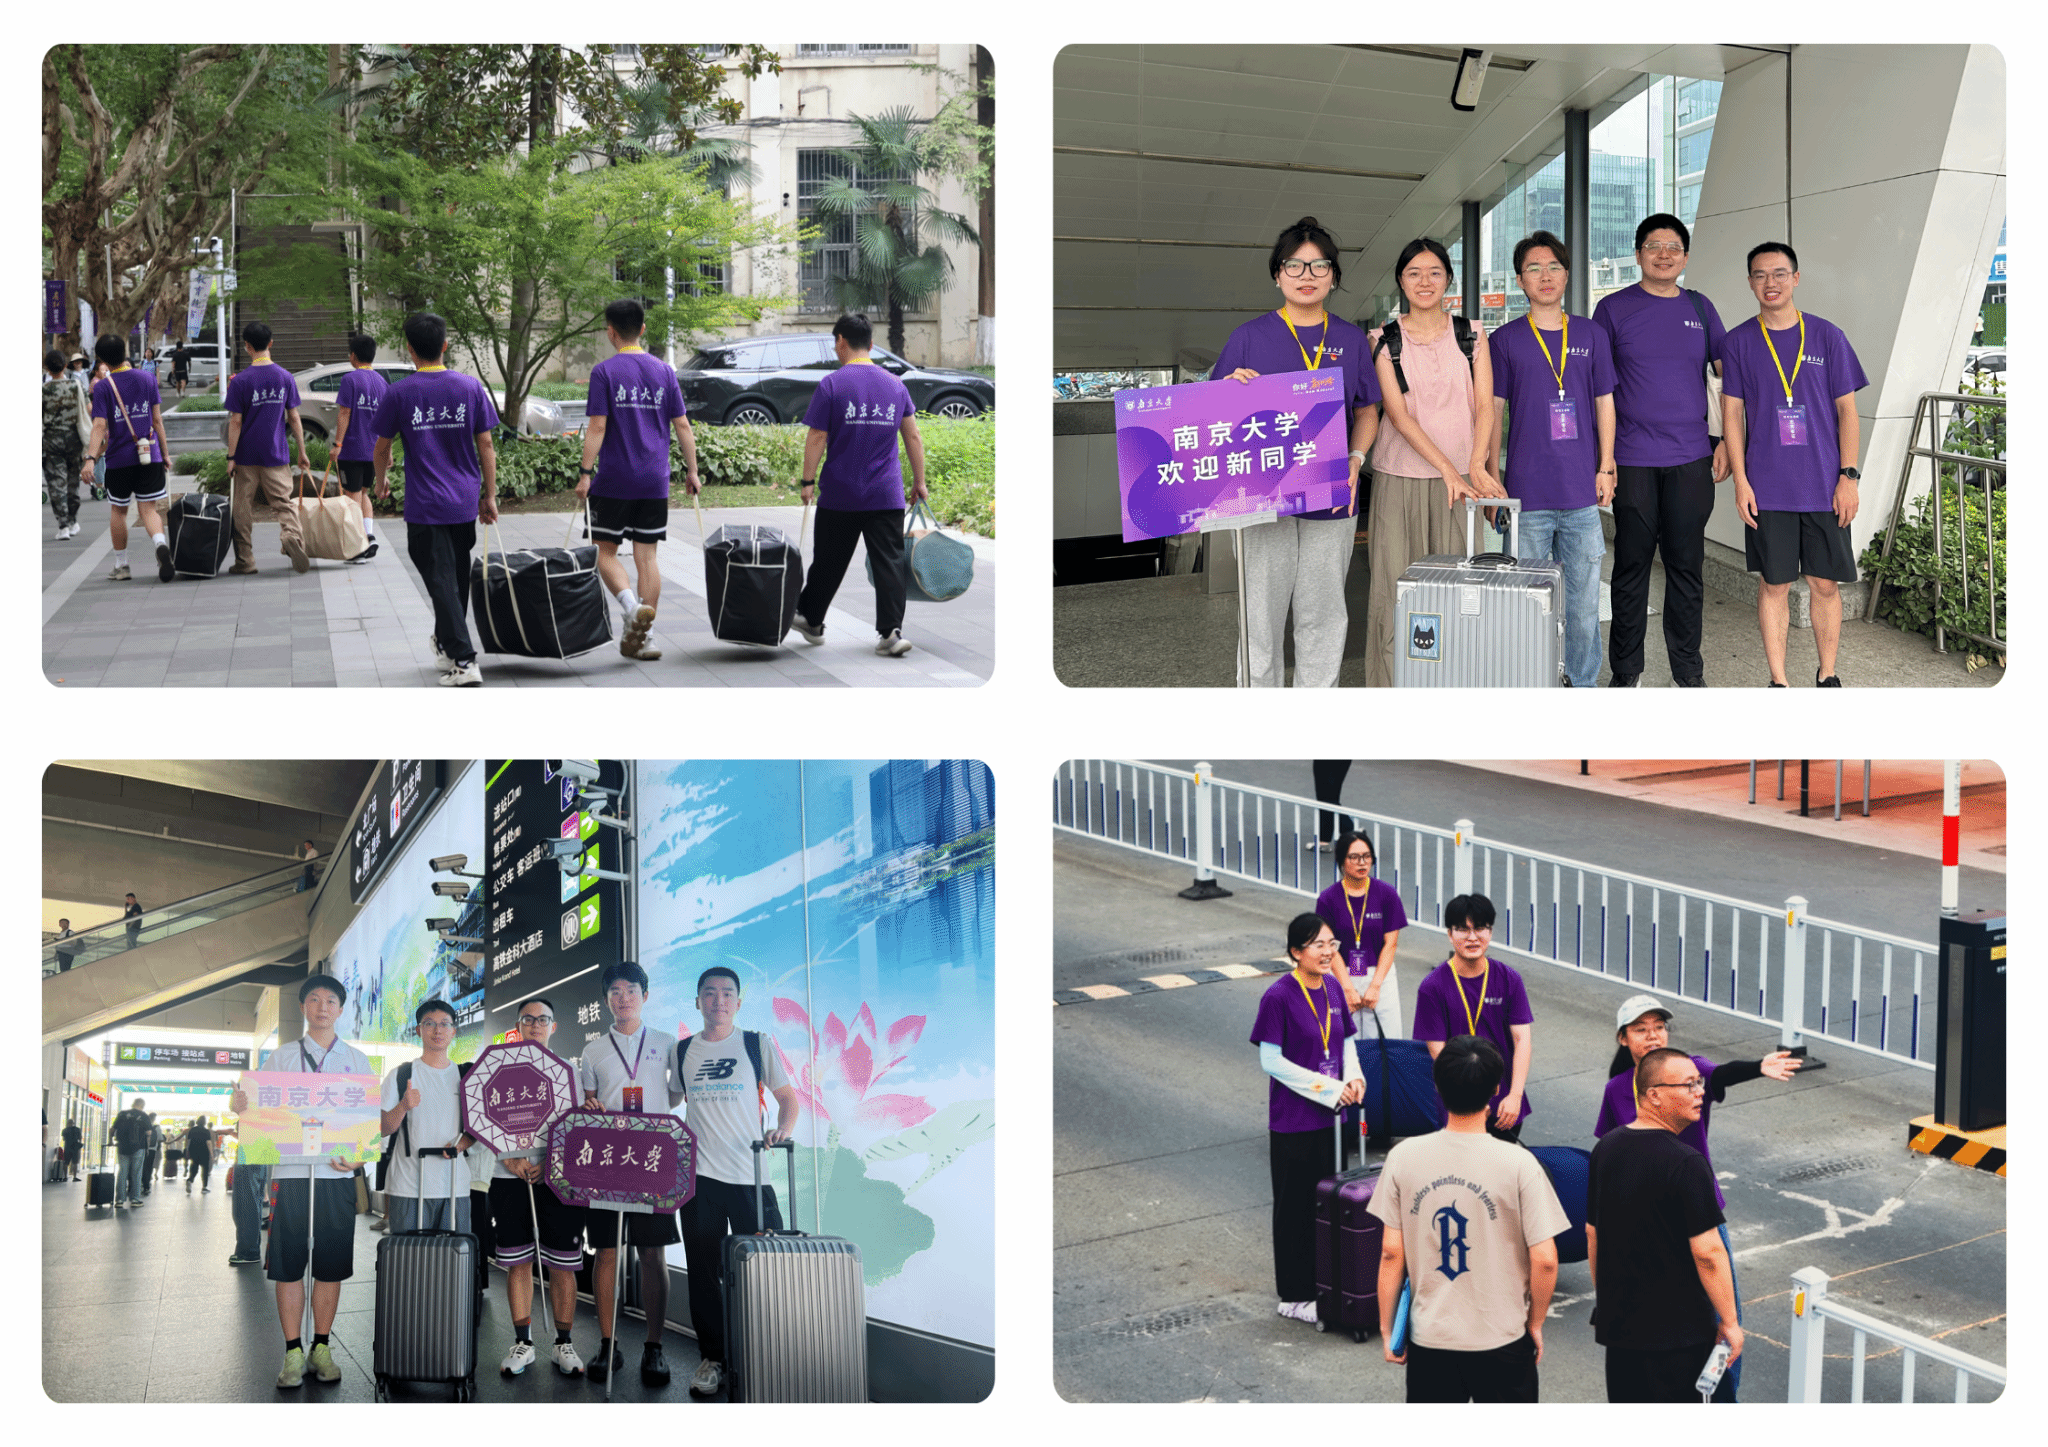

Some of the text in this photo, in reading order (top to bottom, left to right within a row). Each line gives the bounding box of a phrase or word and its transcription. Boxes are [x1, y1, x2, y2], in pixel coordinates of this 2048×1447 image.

[1172, 411, 1299, 452] 南京大学
[1156, 440, 1317, 486] 欢迎新同学
[493, 867, 515, 895] 公交车
[493, 907, 514, 934] 出租车
[577, 1001, 601, 1025] 地铁
[585, 1031, 601, 1041] Metro
[154, 1048, 205, 1057] 停车场 接站点
[230, 1051, 246, 1060] 地铁
[257, 1084, 367, 1108] 南京大学
[705, 1083, 744, 1091] balance
[1431, 1174, 1466, 1191] pointless
[1466, 1182, 1483, 1194] and
[1477, 1190, 1498, 1221] fearless
[1431, 1199, 1472, 1282] B
